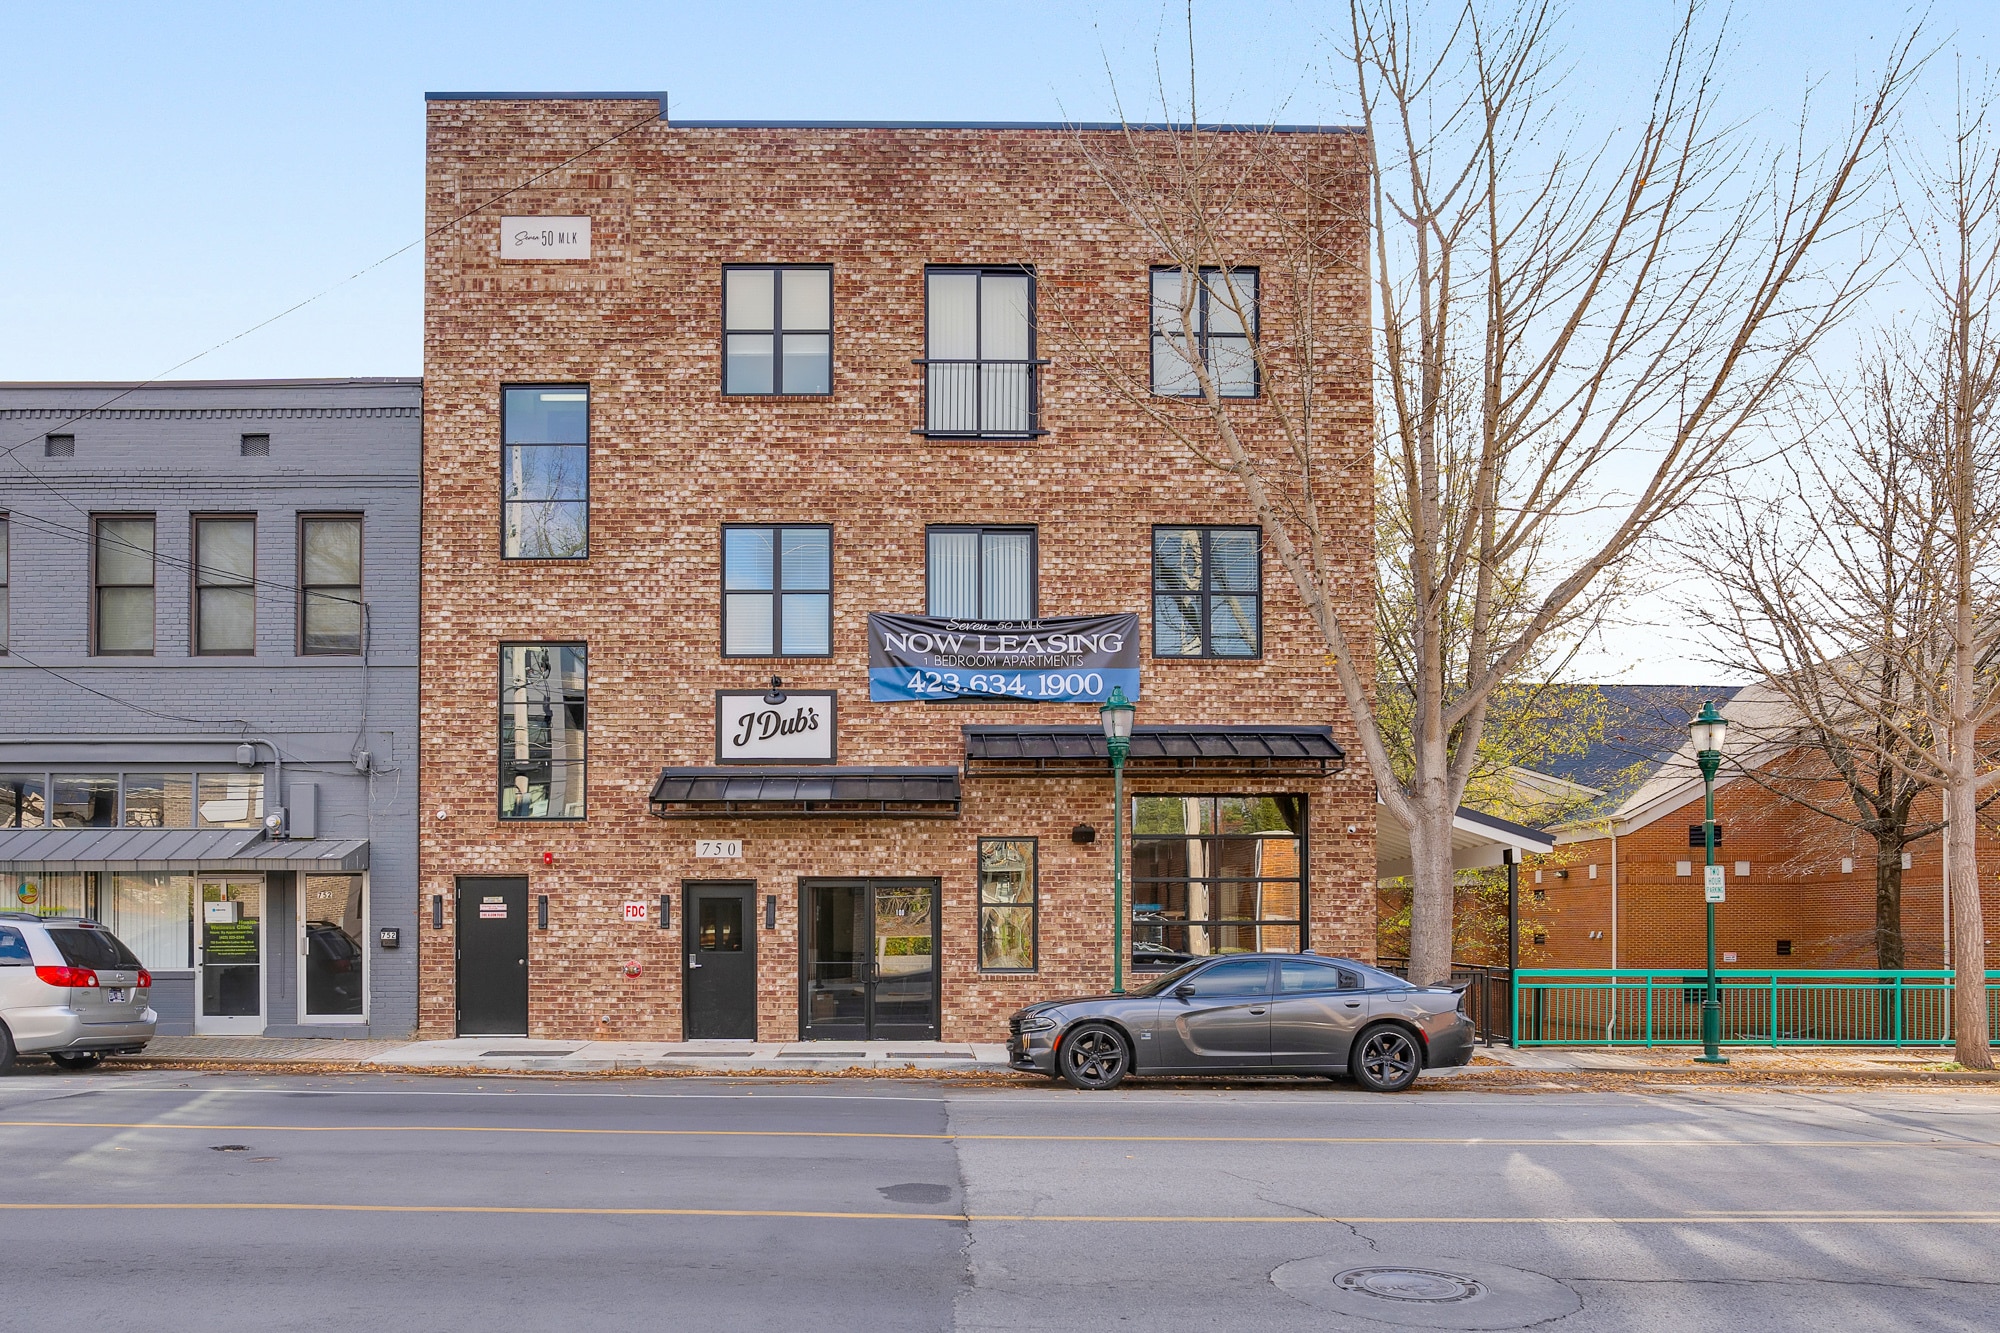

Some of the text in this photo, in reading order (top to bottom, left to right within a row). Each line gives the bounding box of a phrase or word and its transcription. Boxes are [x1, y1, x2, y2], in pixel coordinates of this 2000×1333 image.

[541, 230, 554, 246] 50
[558, 232, 578, 244] MLK
[946, 617, 1045, 631] Seven 50 MLK
[884, 633, 1124, 654] NOW LEASING
[934, 655, 997, 667] BEDROOM
[1002, 654, 1084, 667] APARTMENTS
[907, 671, 1104, 696] 423.634.1900
[702, 842, 736, 856] 750
[1710, 867, 1720, 876] TWO
[1708, 877, 1721, 886] HOUR
[317, 891, 333, 899] 752
[1706, 886, 1724, 894] PARKING
[625, 905, 645, 918] FDC
